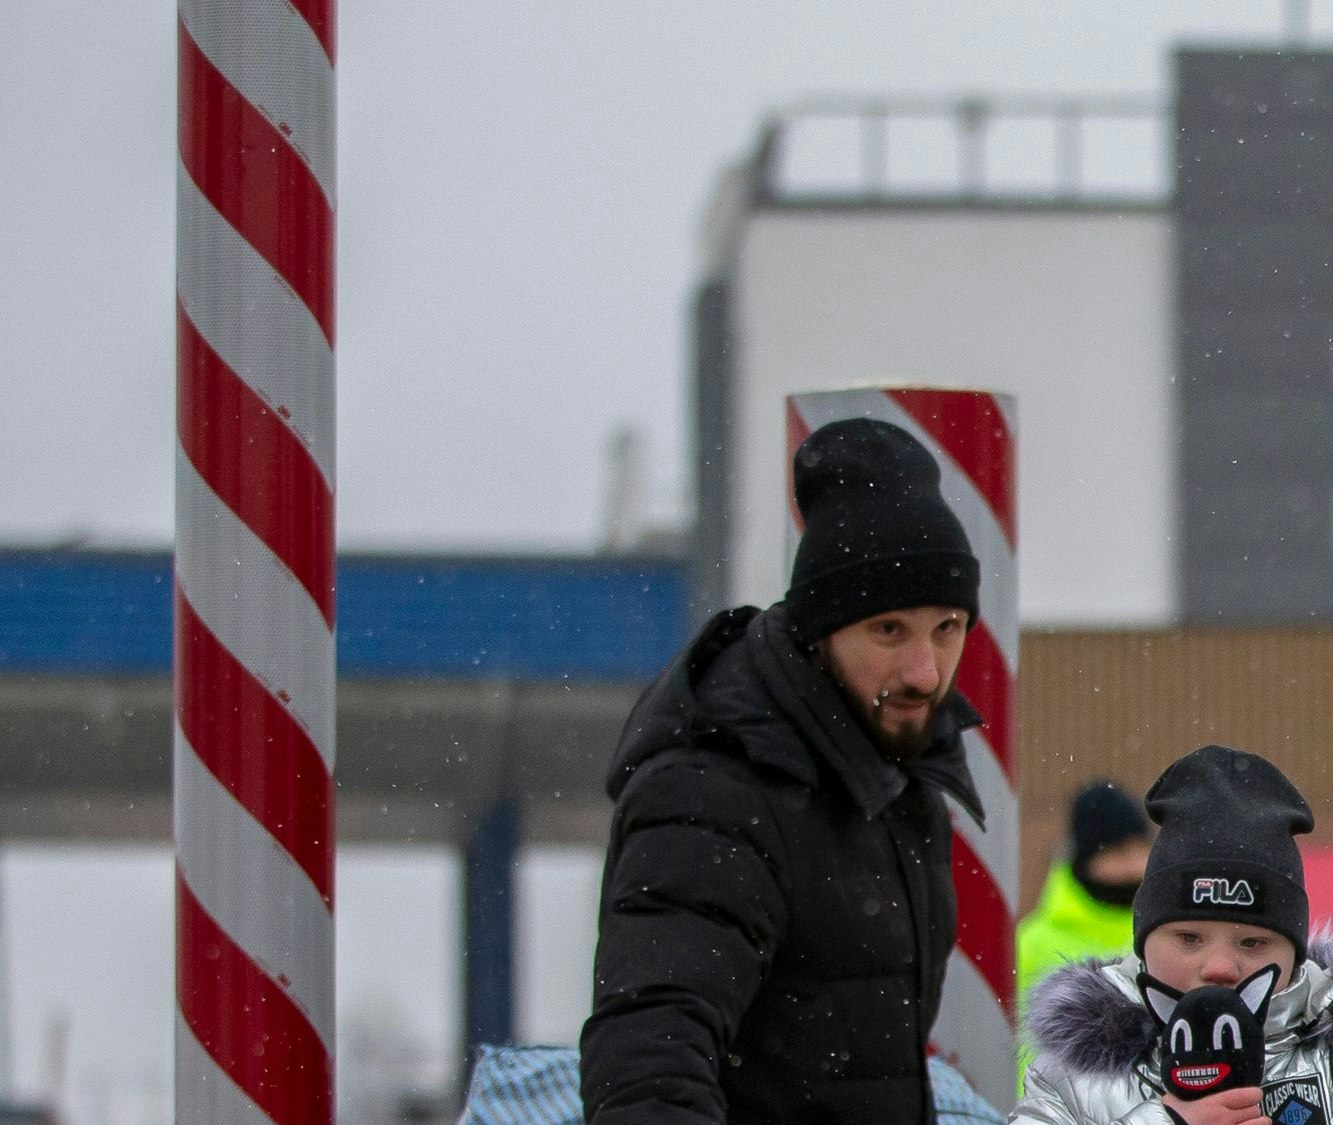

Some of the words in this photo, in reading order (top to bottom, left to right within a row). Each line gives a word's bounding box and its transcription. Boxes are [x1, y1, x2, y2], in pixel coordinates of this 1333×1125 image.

[1193, 878, 1254, 905] FILA
[1265, 1082, 1295, 1117] CLASSIC
[1295, 1083, 1321, 1108] WEAR
